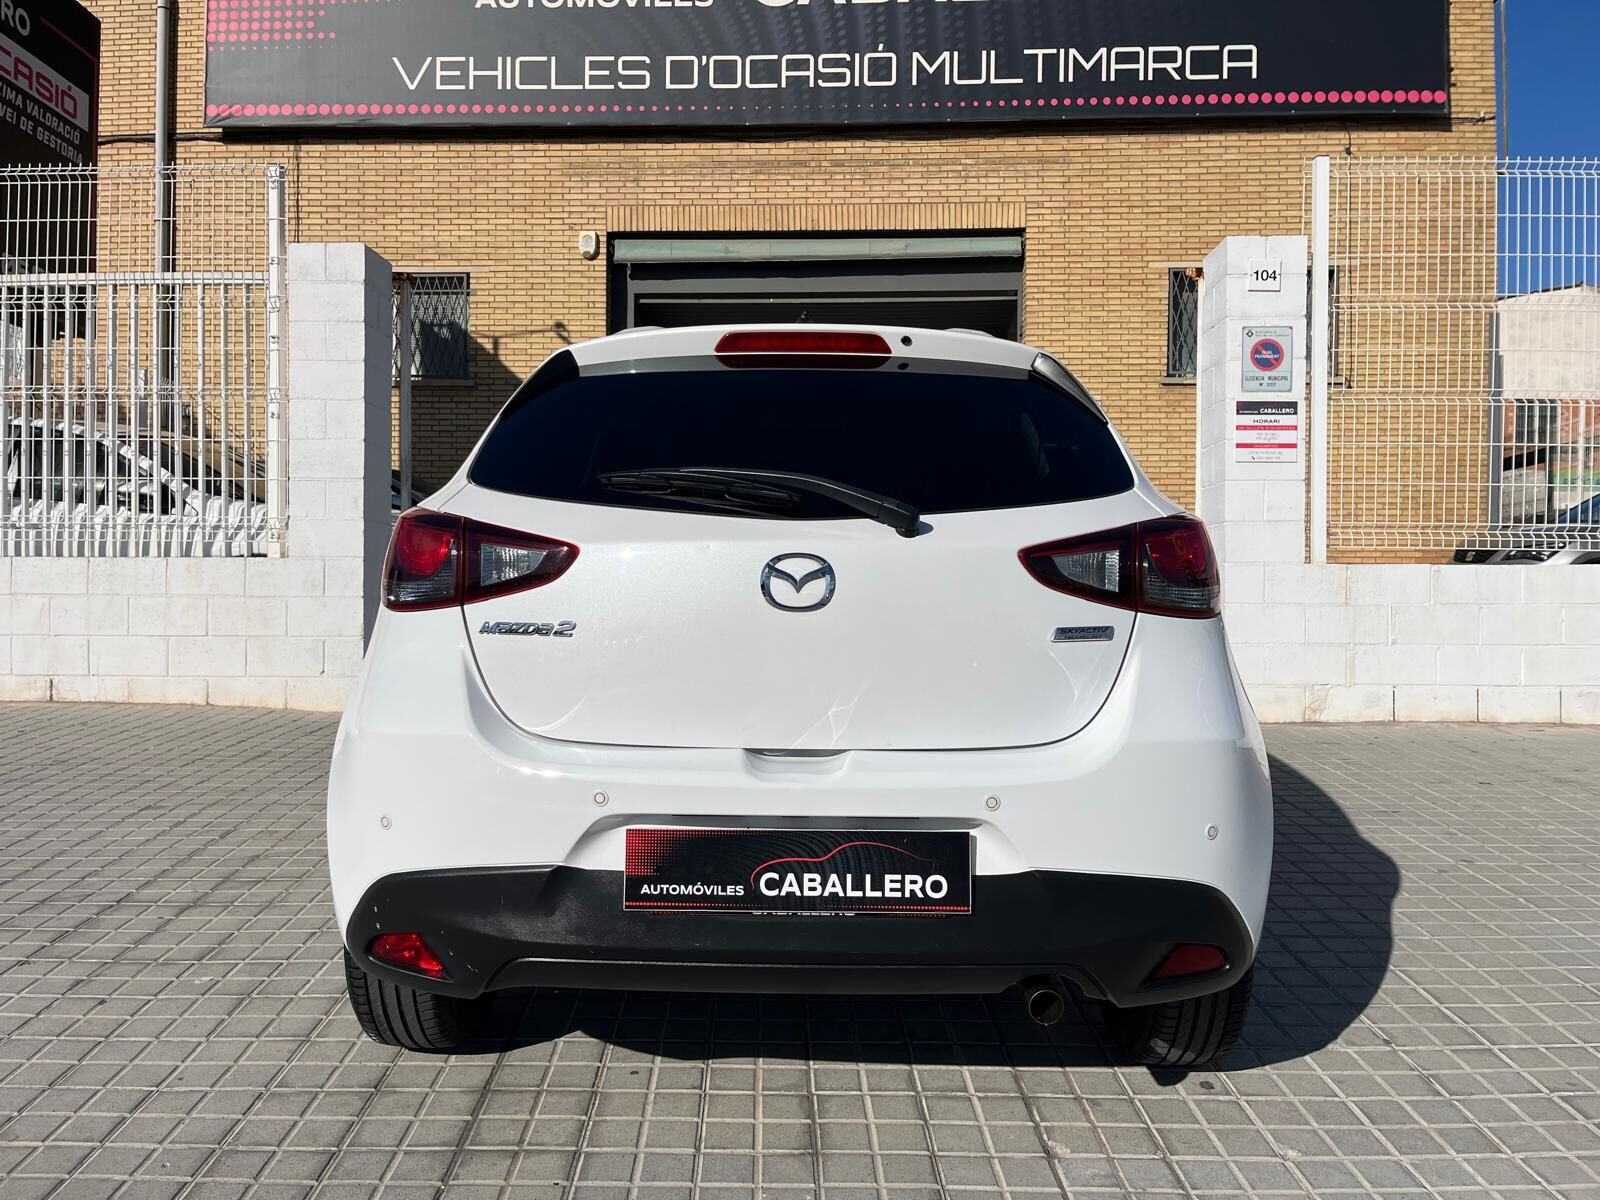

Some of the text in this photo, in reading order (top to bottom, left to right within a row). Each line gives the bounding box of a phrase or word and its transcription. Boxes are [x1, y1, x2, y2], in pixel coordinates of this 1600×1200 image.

[392, 43, 1258, 90] VEHICLES D'OCASIÓ MULTIMARCA
[20, 116, 34, 135] DE
[36, 126, 83, 164] GESTORIA
[26, 98, 80, 145] VALORACIÓ
[1253, 270, 1278, 281] 104
[1059, 627, 1108, 635] SKYACTIV
[641, 872, 949, 899] AUTOMÓVILES CABALLERO
